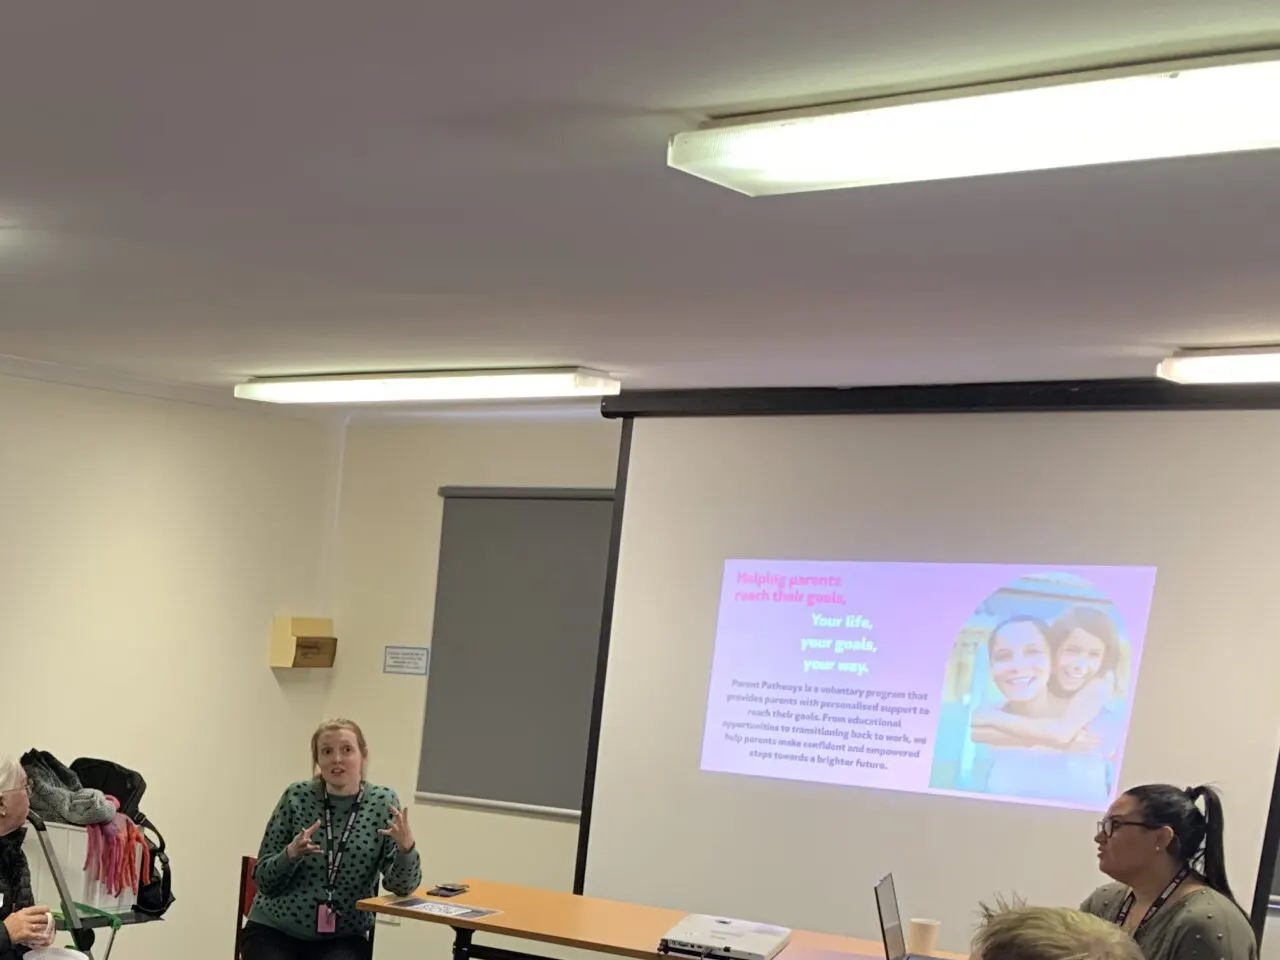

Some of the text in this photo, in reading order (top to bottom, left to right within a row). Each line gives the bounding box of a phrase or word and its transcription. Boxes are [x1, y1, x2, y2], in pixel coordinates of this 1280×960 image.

[737, 572, 786, 589] Helping
[811, 612, 873, 630] Your life,
[801, 636, 877, 653] your goals,
[803, 660, 869, 676] your way.
[731, 679, 760, 689] Parent
[761, 681, 803, 693] Pathways
[804, 684, 813, 692] is
[820, 685, 864, 698] voluntary
[865, 689, 906, 699] program
[907, 691, 928, 700] that
[726, 694, 930, 715] provides parents with personalised support to
[747, 709, 771, 717] reach
[772, 710, 794, 718] their
[822, 713, 846, 723] From
[847, 716, 902, 728] educational
[721, 721, 780, 732] opportunities
[781, 725, 791, 733] to
[791, 726, 849, 740] transitioning
[850, 729, 873, 740] back
[874, 733, 885, 741] to
[724, 732, 921, 759] help parents make confident and empowered
[749, 750, 773, 760] steps
[774, 752, 809, 762] towards
[817, 755, 855, 768] brighter
[855, 758, 888, 770] future.
